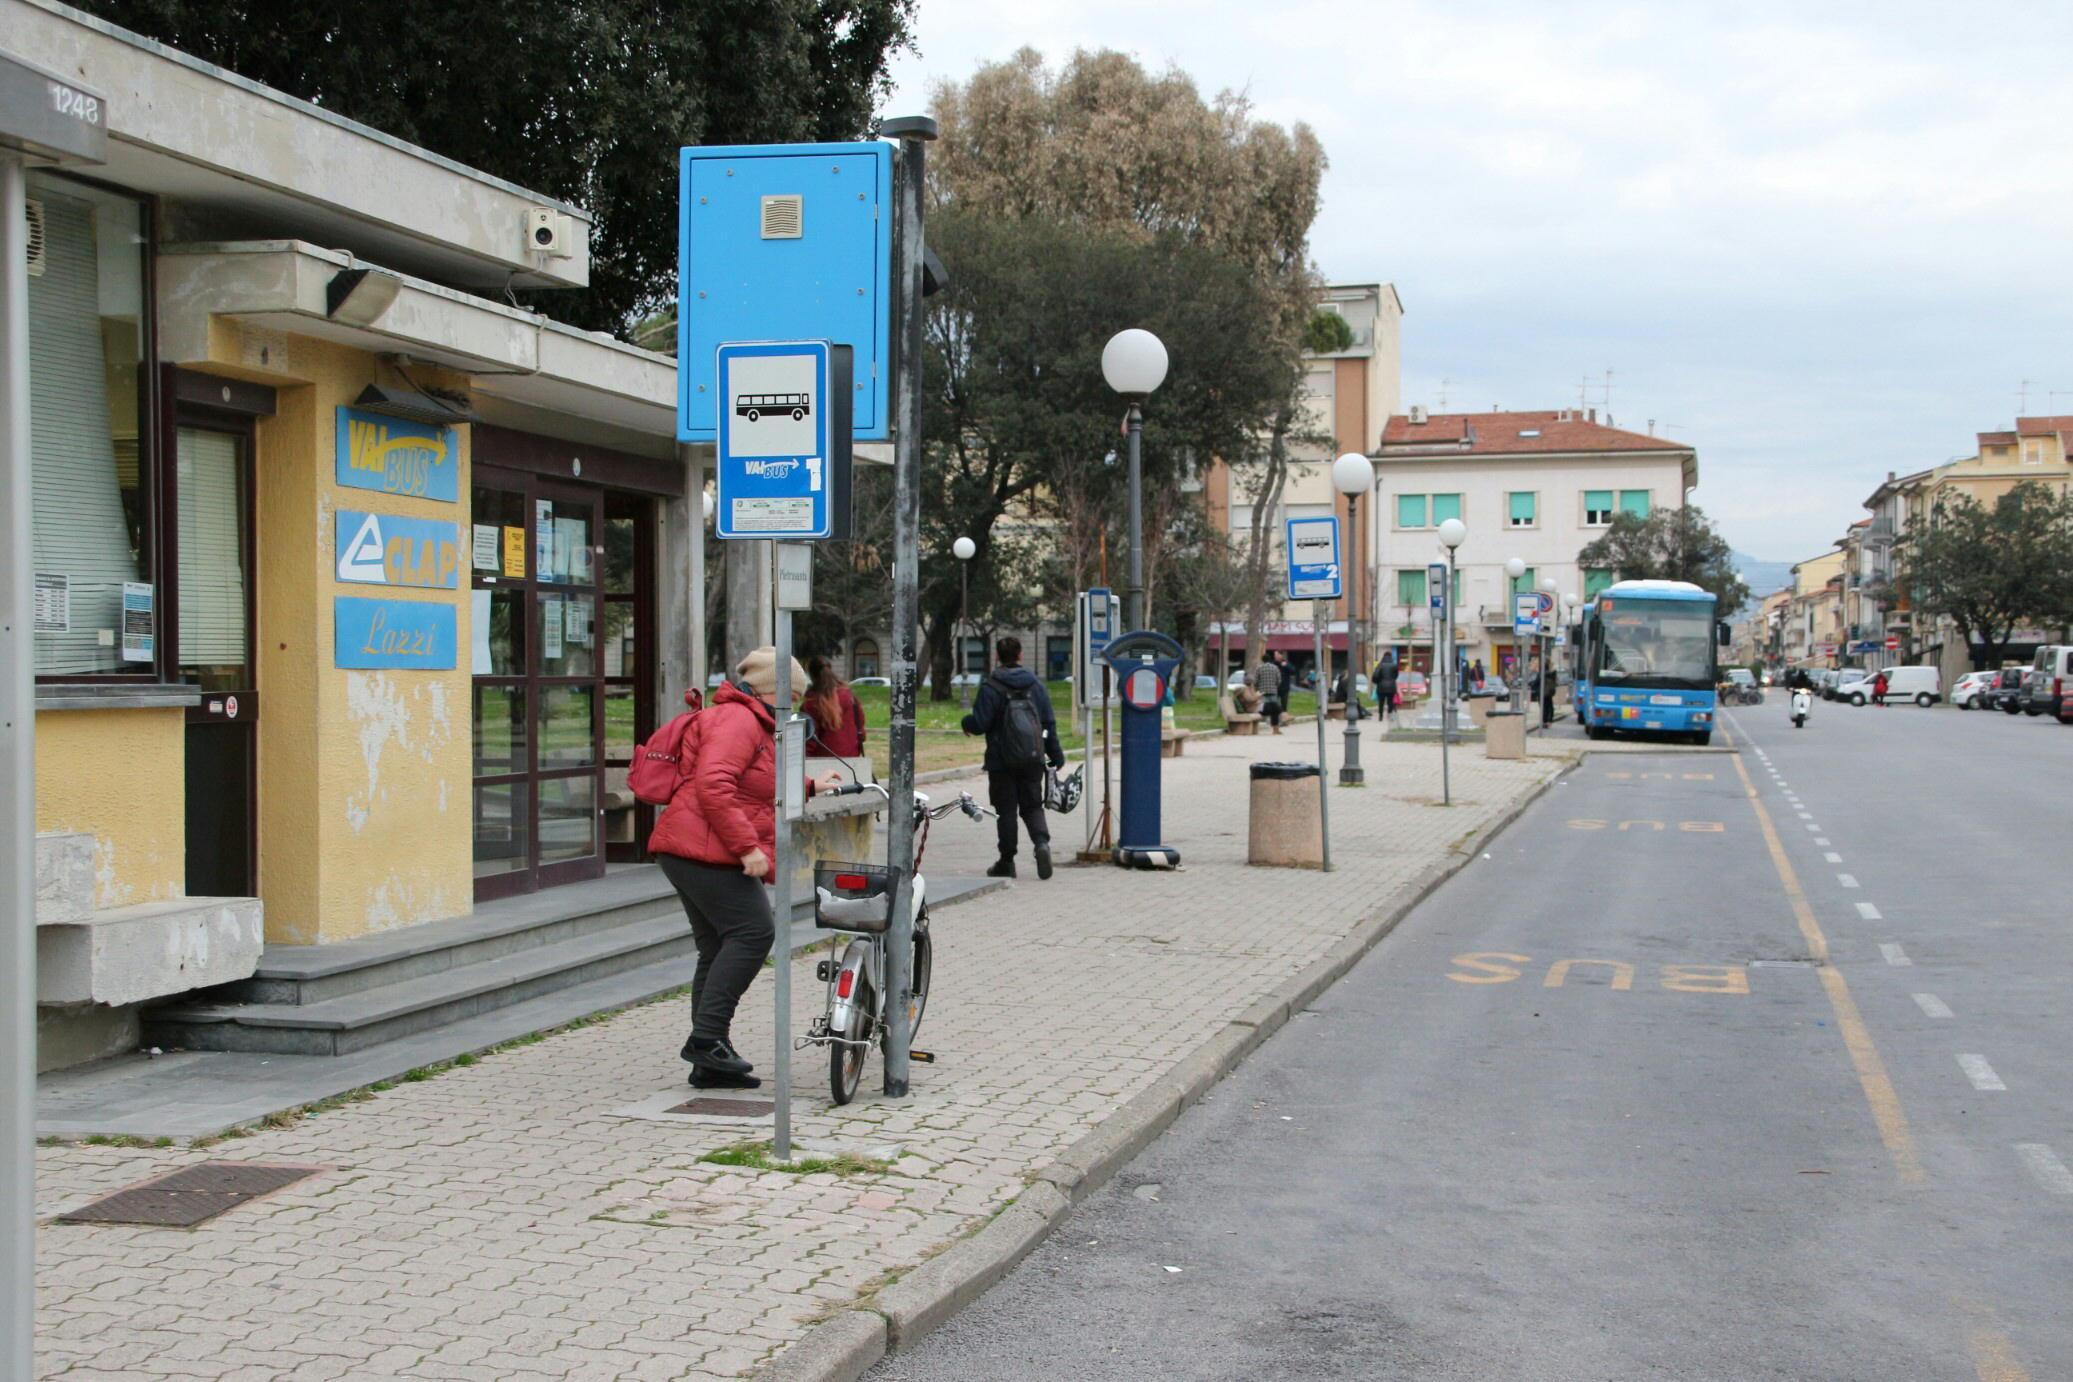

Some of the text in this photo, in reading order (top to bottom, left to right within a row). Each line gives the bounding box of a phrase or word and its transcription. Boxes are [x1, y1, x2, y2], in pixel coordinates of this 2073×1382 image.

[52, 84, 98, 125] 1248
[385, 536, 457, 585] CLAP
[1326, 564, 1338, 579] 2
[362, 607, 435, 655] Lazzi
[1444, 951, 1750, 995] BUS
